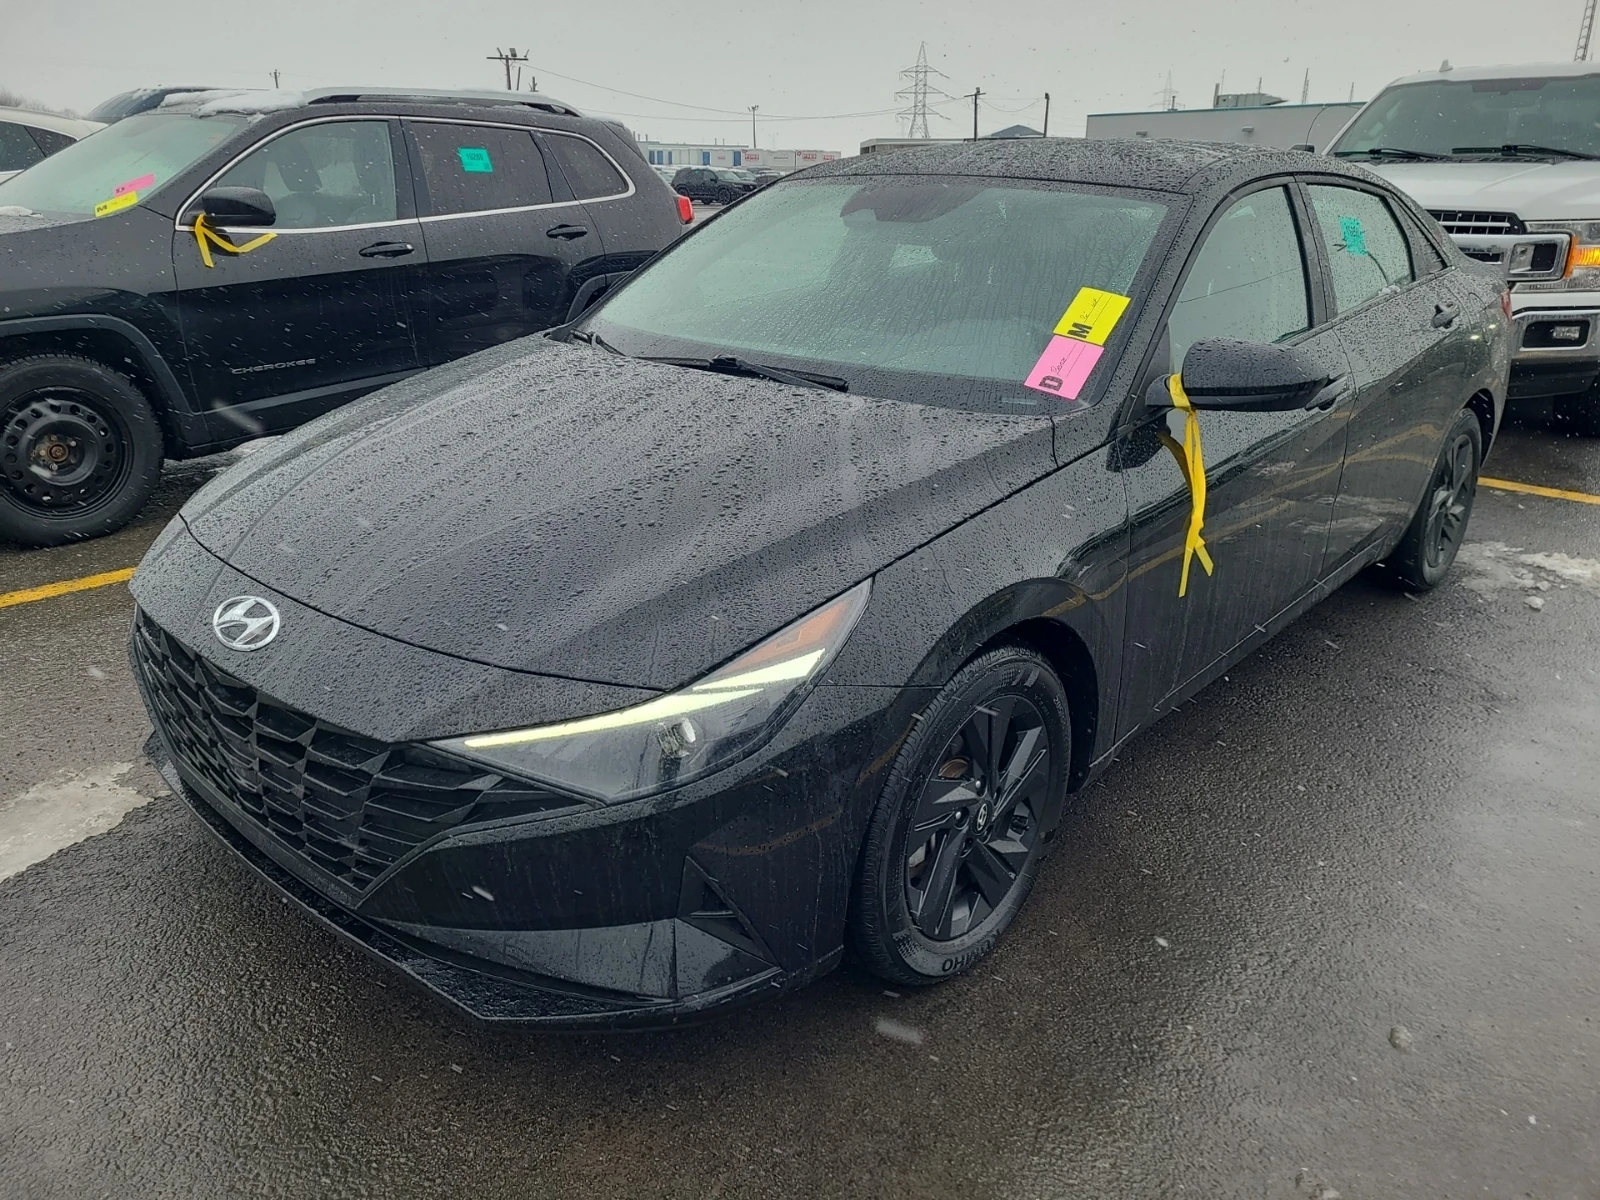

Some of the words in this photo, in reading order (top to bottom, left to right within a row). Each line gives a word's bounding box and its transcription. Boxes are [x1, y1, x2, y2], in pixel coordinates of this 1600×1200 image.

[1067, 322, 1093, 339] M
[231, 358, 316, 375] CHEROKEE
[1039, 375, 1064, 392] D
